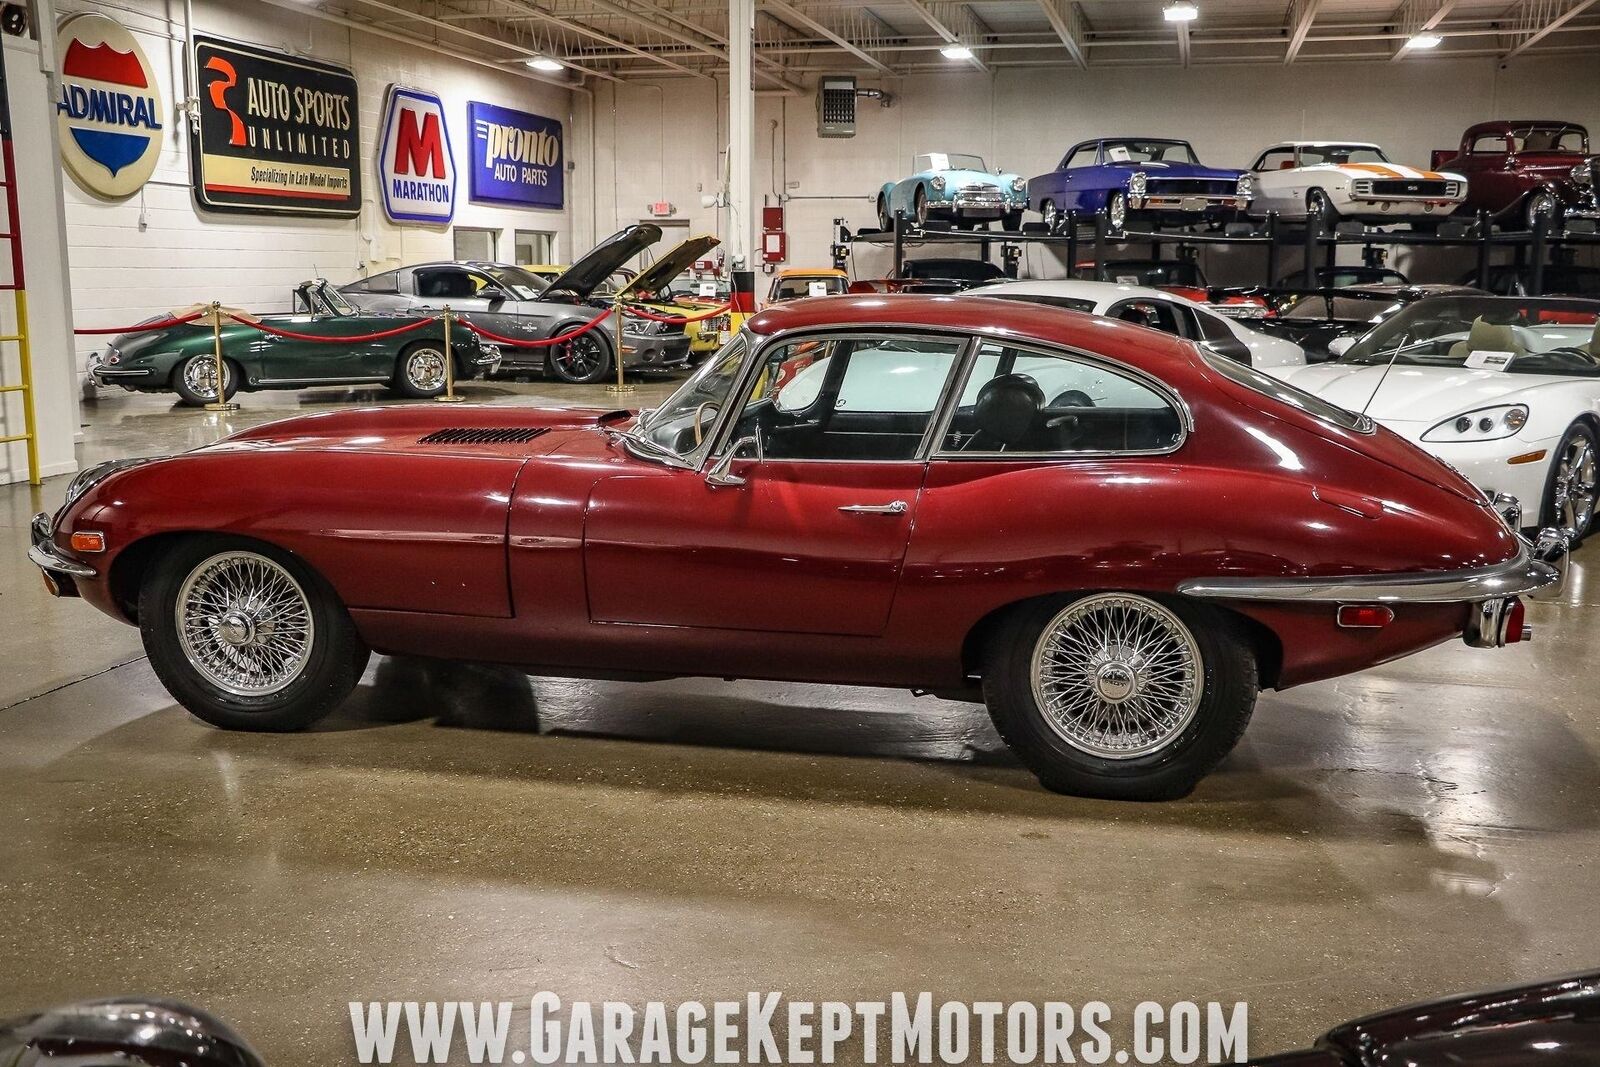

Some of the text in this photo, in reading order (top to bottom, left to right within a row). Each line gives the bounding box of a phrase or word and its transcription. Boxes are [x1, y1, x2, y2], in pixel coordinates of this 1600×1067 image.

[57, 82, 162, 129] ADMIRAL
[248, 77, 350, 131] AUTO SPORTS
[248, 126, 350, 159] UNLIMITED
[394, 107, 446, 180] M
[486, 122, 559, 169] pronto
[251, 166, 348, 191] Specializing In Late Model Imports
[393, 178, 449, 203] MARATHON
[494, 163, 548, 187] AUTO PARTS
